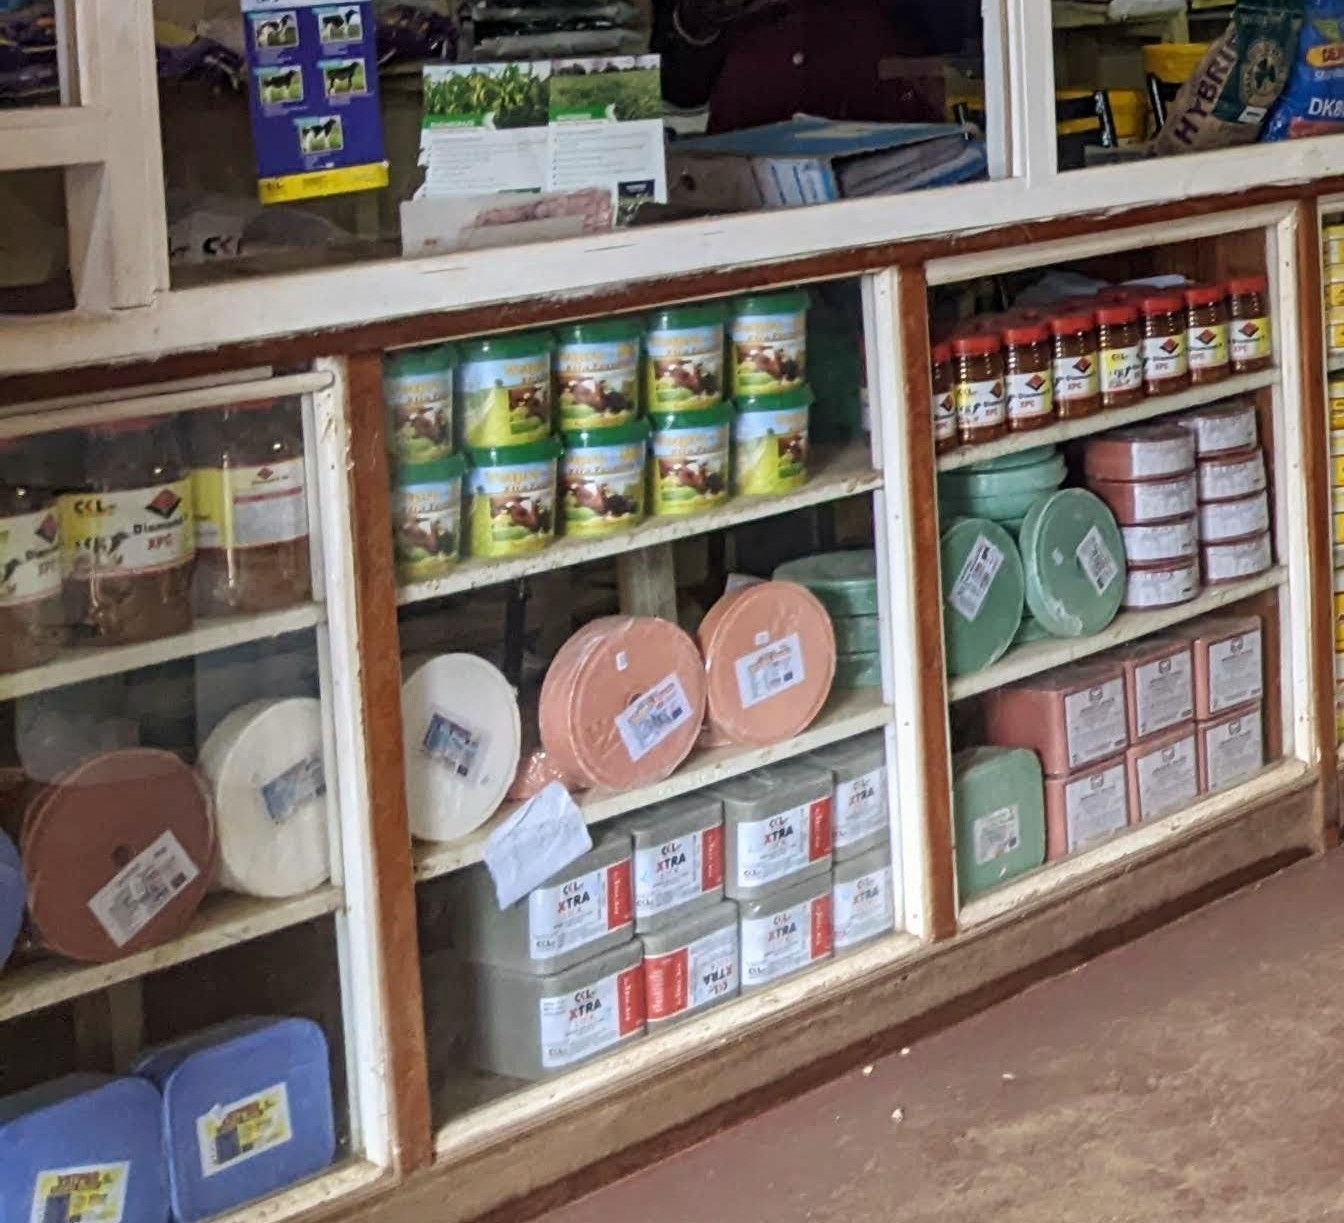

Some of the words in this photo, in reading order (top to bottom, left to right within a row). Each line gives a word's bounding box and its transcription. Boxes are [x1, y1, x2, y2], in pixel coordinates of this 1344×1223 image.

[1173, 36, 1240, 146] HYBRI
[764, 826, 794, 844] XTRA
[656, 853, 686, 872] XTRA
[557, 891, 590, 913] XTRA
[768, 922, 797, 942] XTRA
[568, 998, 602, 1021] XTRA
